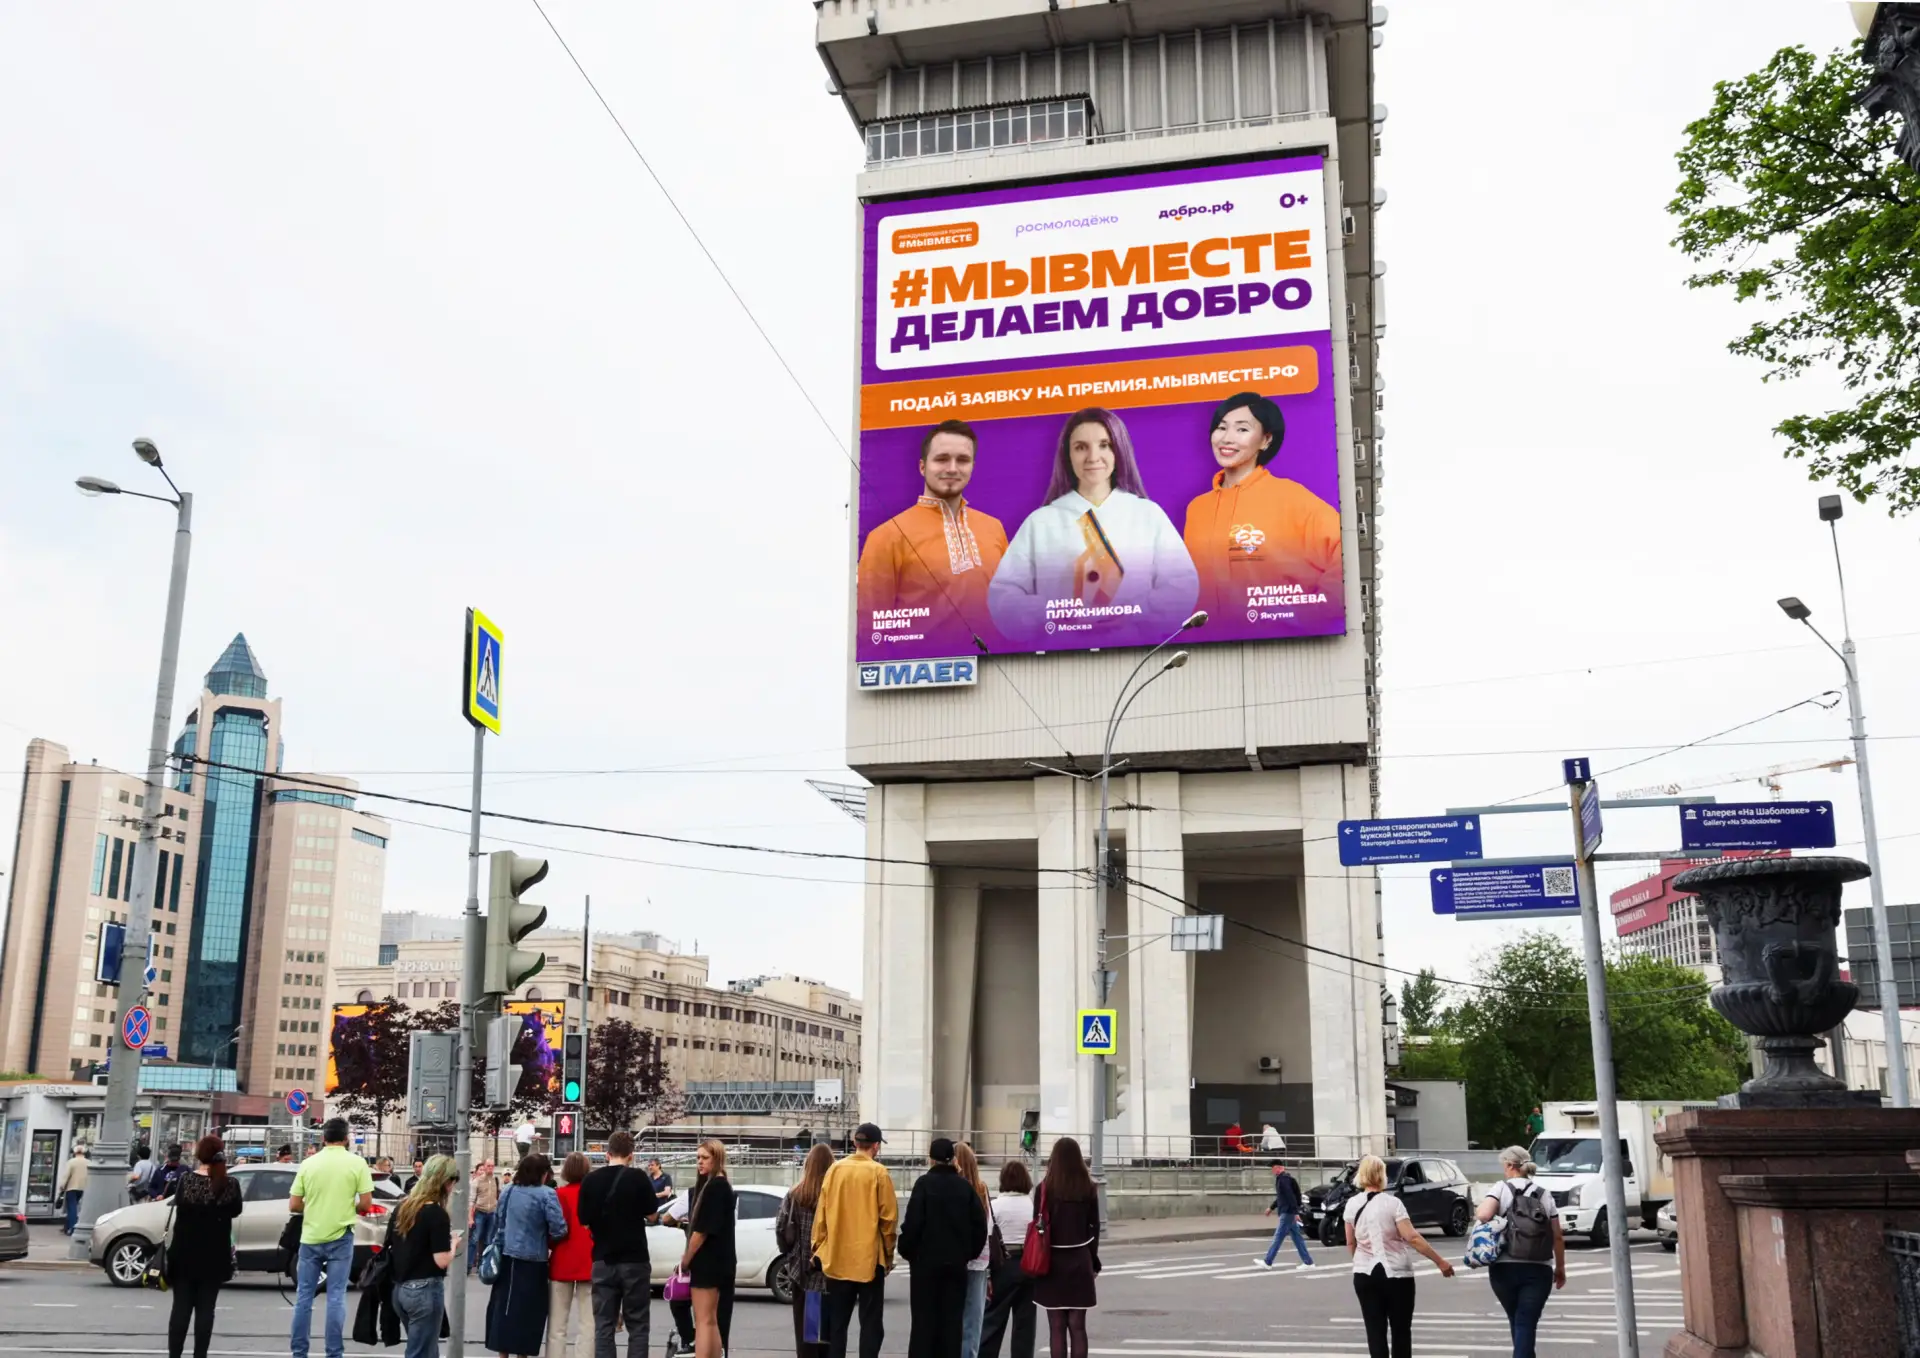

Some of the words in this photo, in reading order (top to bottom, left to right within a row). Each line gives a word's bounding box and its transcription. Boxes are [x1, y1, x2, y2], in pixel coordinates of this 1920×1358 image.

[1279, 192, 1308, 209] 0+
[1158, 200, 1234, 220] добро.рф
[1014, 213, 1119, 238] росмолодёжь
[899, 234, 972, 248] #МЫВМЕСТЕ
[890, 229, 1312, 308] #МЫВМЕСТЕ
[890, 297, 1109, 353] ДЕЛАЕМ
[1121, 278, 1312, 331] ДОБРО
[890, 391, 956, 412] ПОДАЙ
[961, 387, 1032, 406] ЗАЯВКУ
[1038, 384, 1064, 399] НА
[1068, 364, 1299, 397] ПРЕМИЯ.МЫВМЕСТЕ.РФ
[1247, 584, 1303, 596] ГАЛИНА
[1046, 598, 1084, 609] АННА
[1247, 594, 1327, 607] АЛЕКСЕЕВА
[872, 608, 930, 620] МАКСИМ
[1046, 605, 1142, 619] ПЛУЖНИКОВА
[1261, 612, 1294, 620] Якутия
[873, 619, 911, 630] ШЕИН
[884, 634, 924, 642] Горловка
[884, 661, 972, 685] MAER
[1702, 809, 1736, 818] Галерея
[1756, 807, 1810, 816] Шаболовке»
[1392, 821, 1458, 831] ставропигиальный
[1360, 832, 1391, 840] мужской
